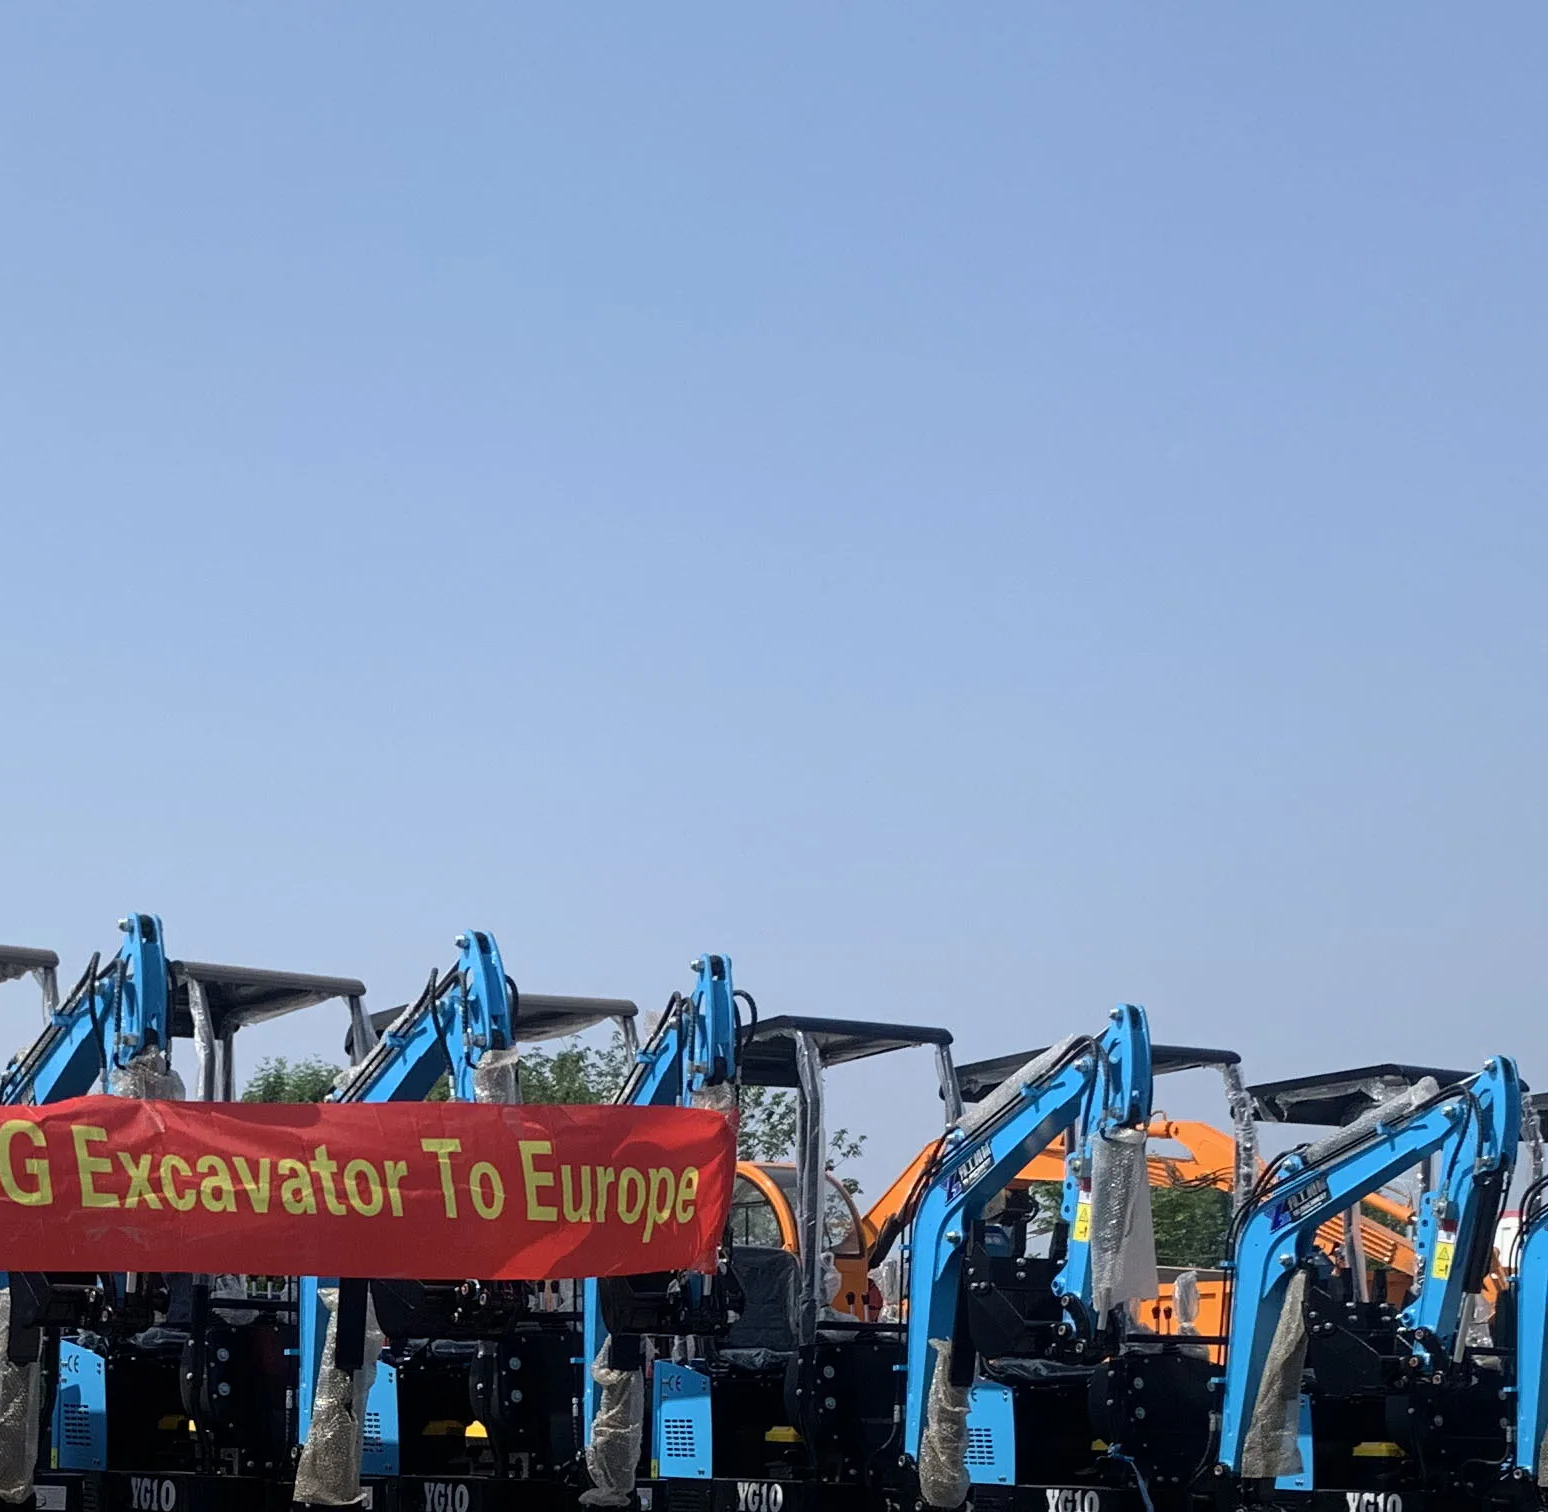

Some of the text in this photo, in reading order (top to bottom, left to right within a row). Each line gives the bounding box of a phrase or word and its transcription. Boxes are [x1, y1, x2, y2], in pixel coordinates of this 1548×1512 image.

[69, 1124, 408, 1219] Excavator
[420, 1137, 505, 1220] To
[518, 1139, 701, 1243] Europe
[130, 1476, 177, 1512] YG10
